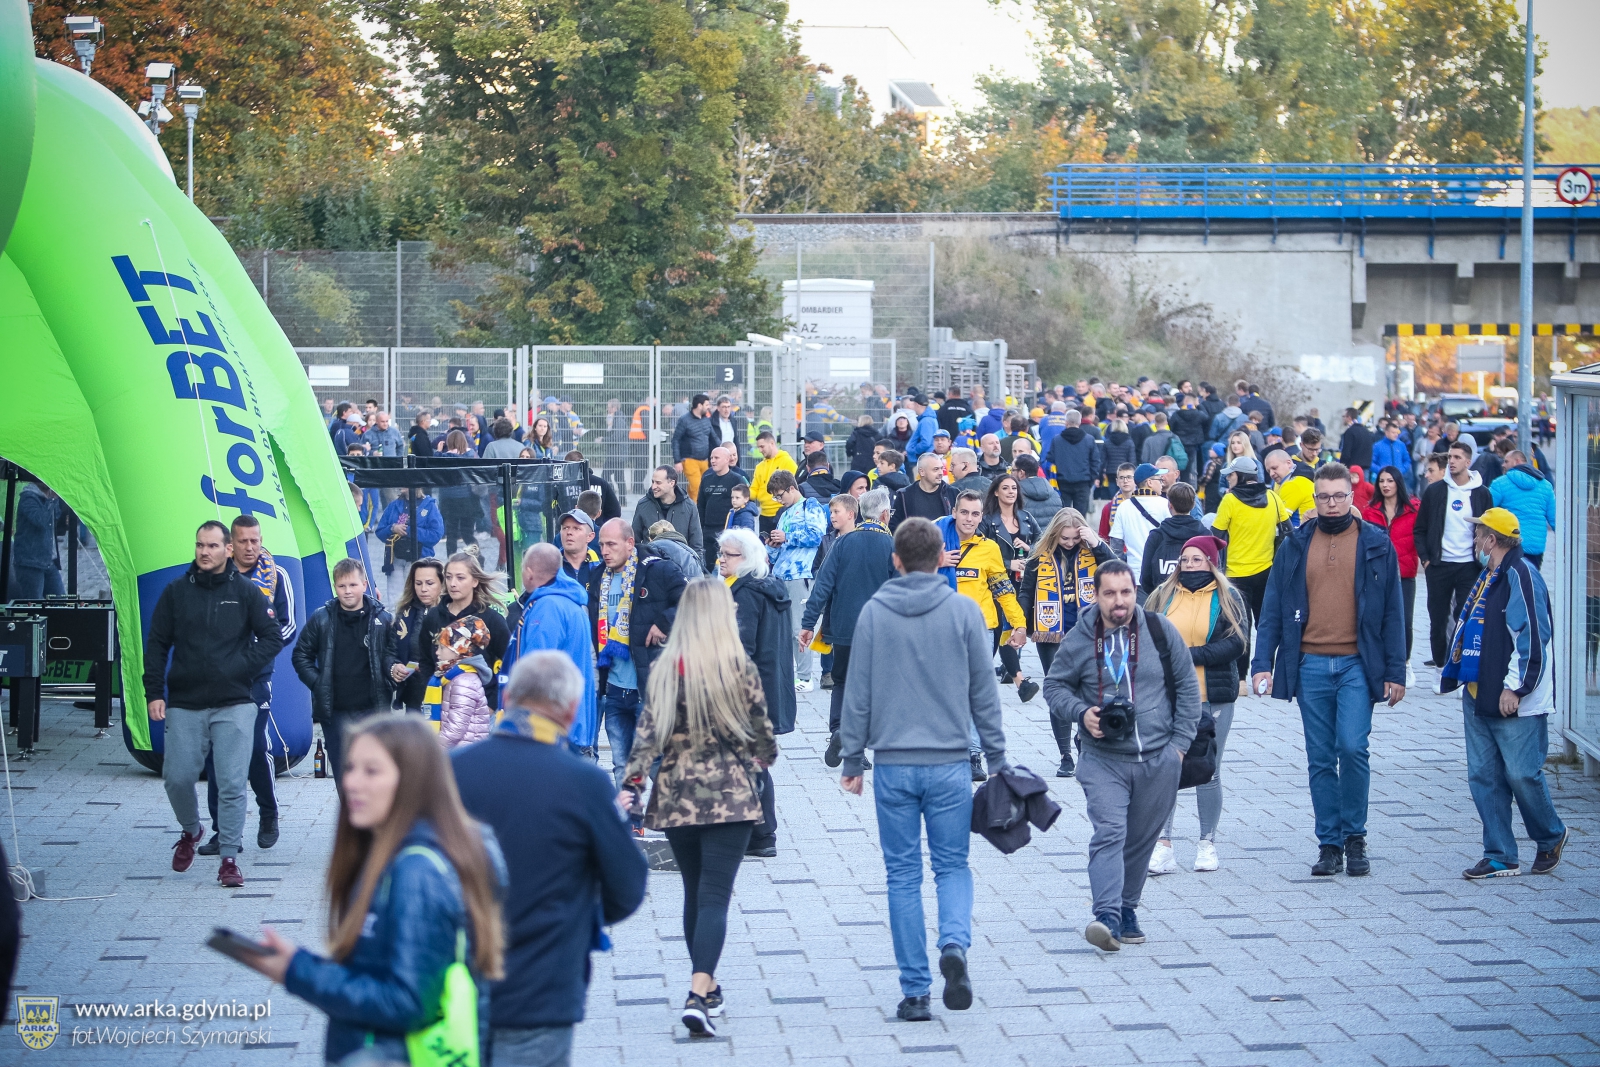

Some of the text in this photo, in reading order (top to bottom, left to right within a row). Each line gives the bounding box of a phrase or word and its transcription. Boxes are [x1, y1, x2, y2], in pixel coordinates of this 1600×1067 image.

[1563, 179, 1587, 194] 3m
[800, 306, 844, 314] OMBARDIER
[455, 369, 466, 383] 4
[724, 368, 734, 381] 3
[111, 255, 277, 519] forBET
[1159, 558, 1179, 575] VA
[1462, 648, 1481, 657] GDYN
[42, 660, 85, 679] orBET
